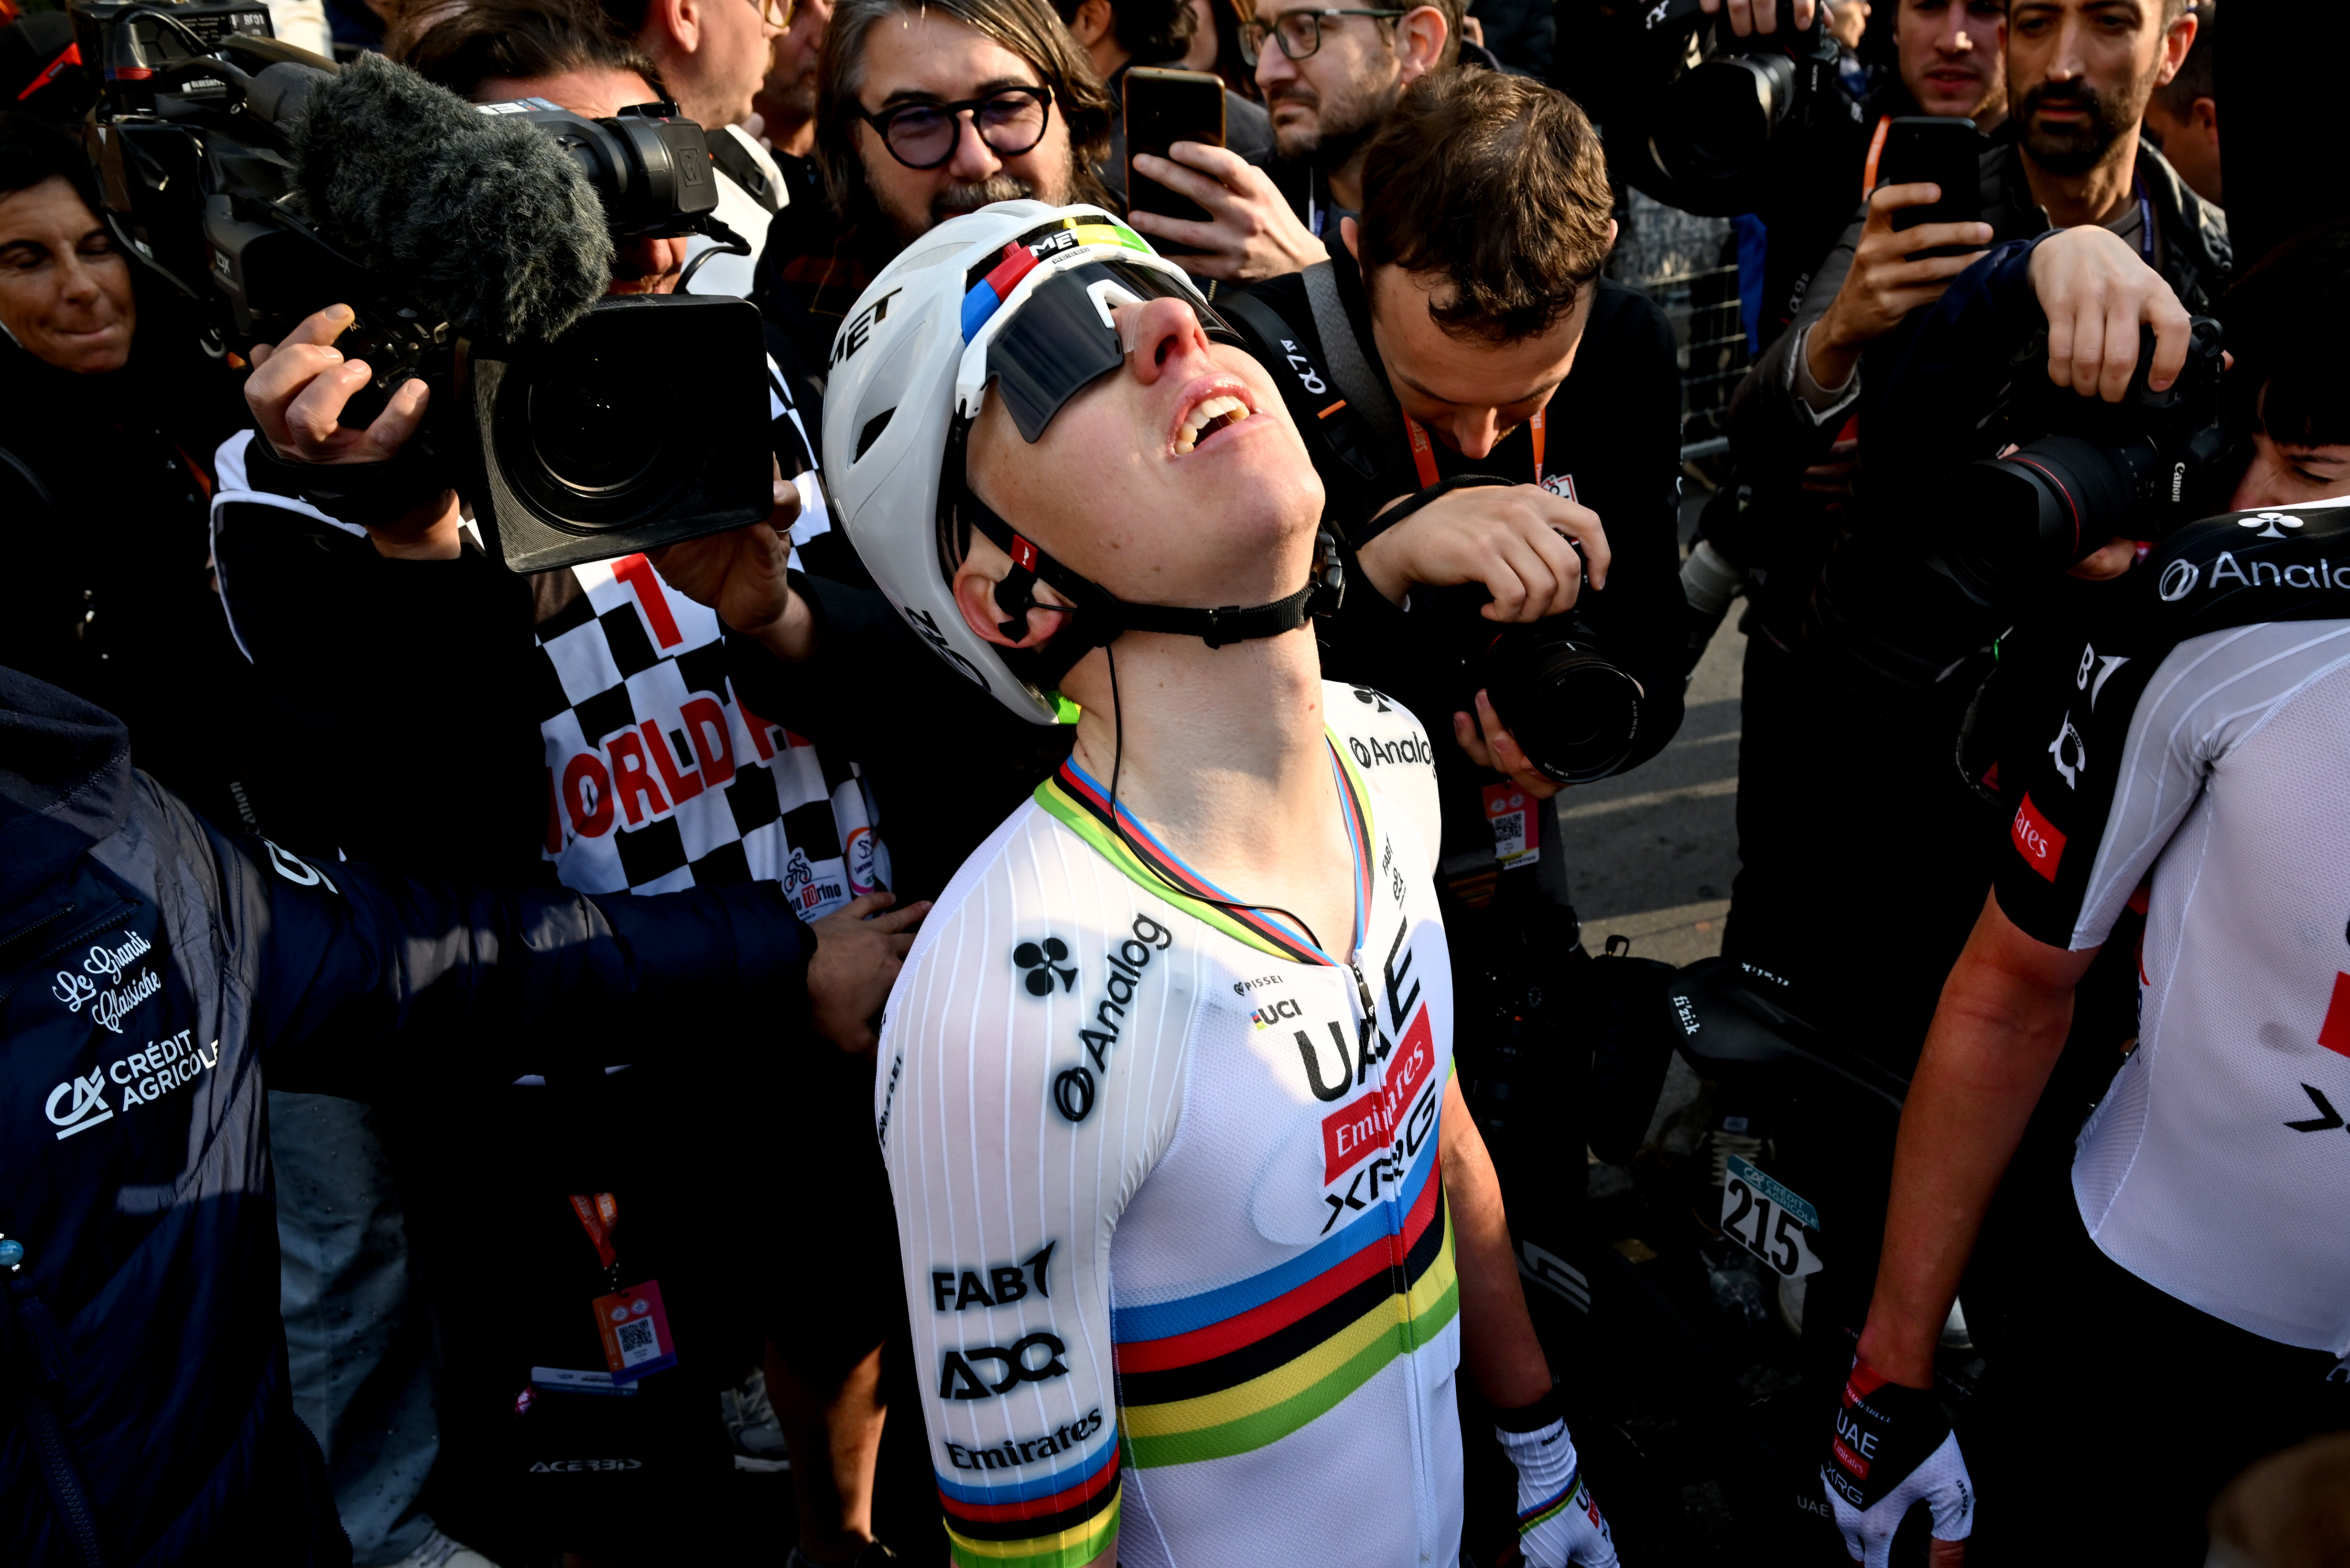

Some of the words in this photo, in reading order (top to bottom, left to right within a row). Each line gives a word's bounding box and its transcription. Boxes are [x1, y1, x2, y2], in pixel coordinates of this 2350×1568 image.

[1029, 228, 1080, 257] MET
[2171, 462, 2186, 503] Canon
[2209, 551, 2350, 589] Analo
[2014, 805, 2048, 859] rates
[52, 971, 97, 1012] Le
[84, 930, 151, 984] Grandi
[1079, 913, 1172, 1073] Analog
[1245, 975, 1283, 991] PISSEI
[92, 967, 161, 1033] Classiche
[1257, 998, 1302, 1025] UCI
[1293, 914, 1420, 1102] UAE
[110, 1029, 192, 1084] CRÉDIT
[1321, 1078, 1435, 1235] XRG
[1722, 1179, 1799, 1275] 215
[1765, 1189, 1818, 1227] AGRICOLE
[940, 1332, 1069, 1400] ADQ
[944, 1407, 1103, 1471] Emirates
[1833, 1439, 1863, 1474] Emirates
[1837, 1407, 1879, 1460] UAE
[529, 1458, 642, 1473] ACERBIS
[1826, 1460, 1864, 1505] XRG
[1797, 1494, 1830, 1518] UAE
